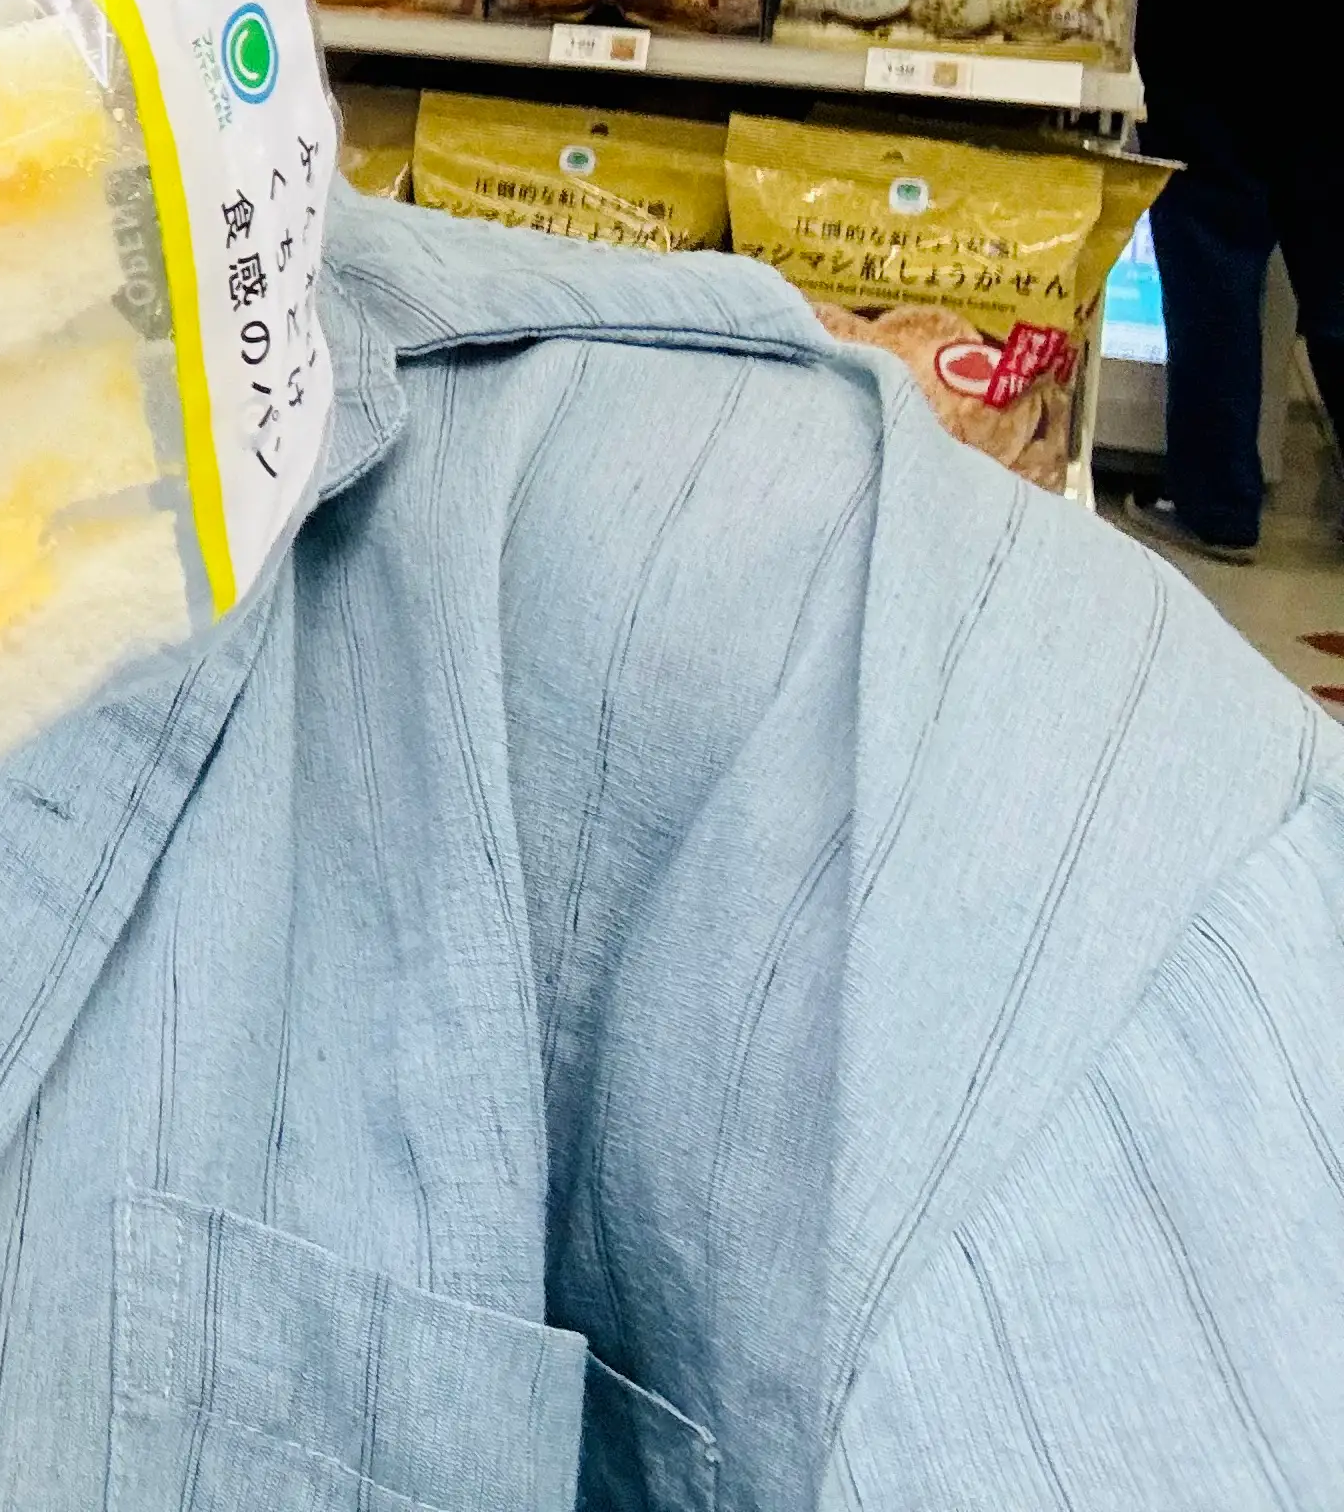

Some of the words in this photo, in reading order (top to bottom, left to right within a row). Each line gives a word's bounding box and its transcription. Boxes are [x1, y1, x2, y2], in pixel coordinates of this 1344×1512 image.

[221, 188, 278, 480] 食感のパン
